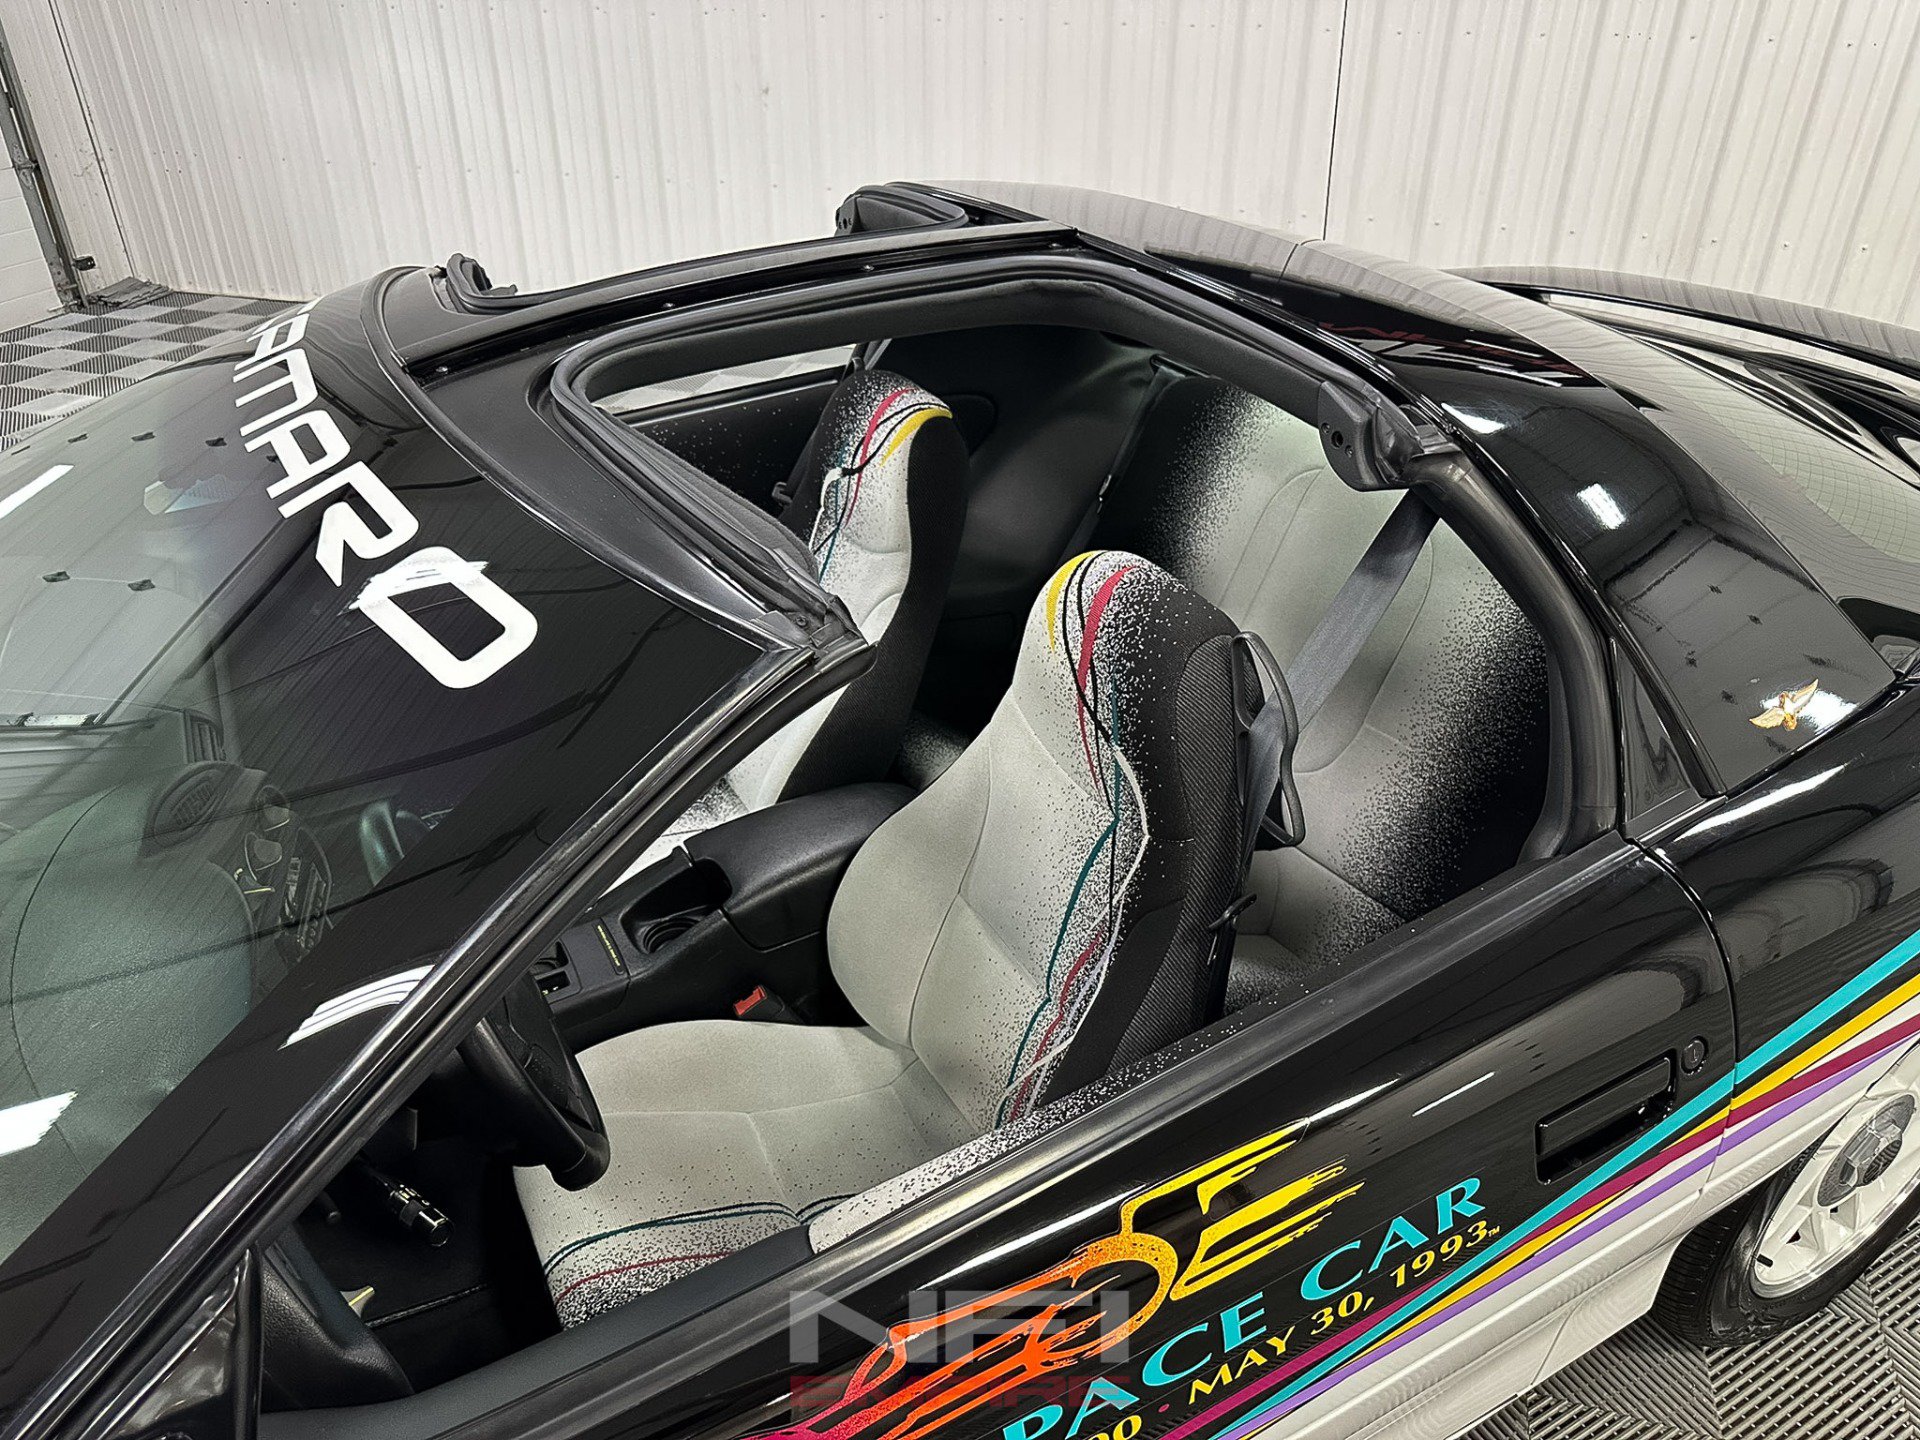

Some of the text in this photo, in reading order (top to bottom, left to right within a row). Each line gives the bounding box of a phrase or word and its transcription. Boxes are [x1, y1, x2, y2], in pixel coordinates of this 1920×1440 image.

[232, 298, 539, 690] AMARO
[1002, 1177, 1487, 1440] PACE CAR
[1188, 1325, 1297, 1405] MAY
[1309, 1290, 1375, 1336] 30,
